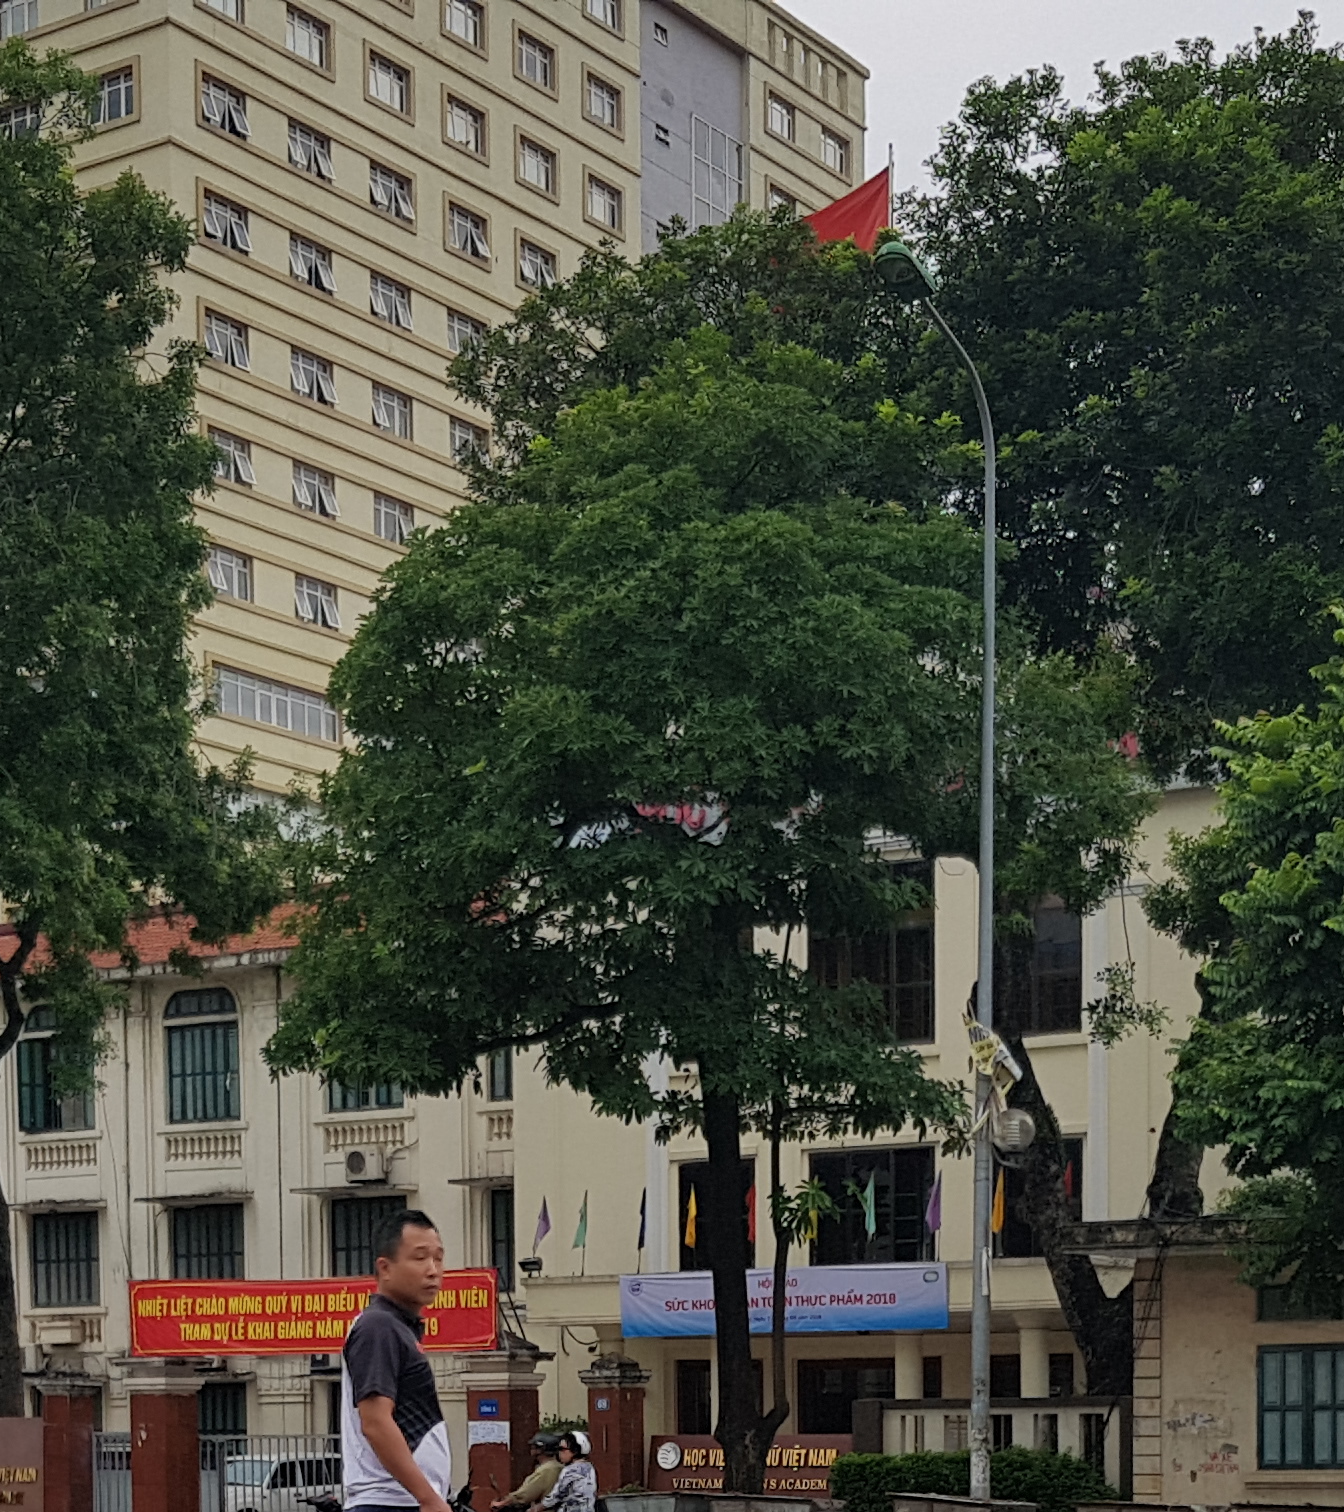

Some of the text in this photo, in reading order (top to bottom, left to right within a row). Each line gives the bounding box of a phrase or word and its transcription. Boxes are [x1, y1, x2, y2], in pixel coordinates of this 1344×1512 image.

[138, 1296, 169, 1321] NHIỆT
[170, 1294, 193, 1321] LIỆT
[195, 1293, 226, 1317] CHÀO
[228, 1293, 262, 1316] MỪNG
[265, 1291, 288, 1316] QUÝ
[291, 1294, 303, 1318] VỊ
[305, 1293, 325, 1318] ĐẠI
[327, 1285, 355, 1312] BIỂU
[459, 1285, 489, 1309] VIÊN
[664, 1298, 689, 1311] SỨC
[692, 1298, 717, 1311] KHO
[761, 1296, 792, 1308] TON
[794, 1294, 827, 1309] THỰC
[866, 1292, 897, 1305] 2018
[180, 1315, 439, 1344] THAM DỰ LỄ KHAI GIẢNG NĂM 19
[683, 1449, 707, 1471] HỌC
[709, 1448, 726, 1471] VIỆ
[782, 1443, 807, 1472] VIỆT
[808, 1448, 838, 1468] NAM
[672, 1477, 829, 1490] VIETNAM ACADEM
